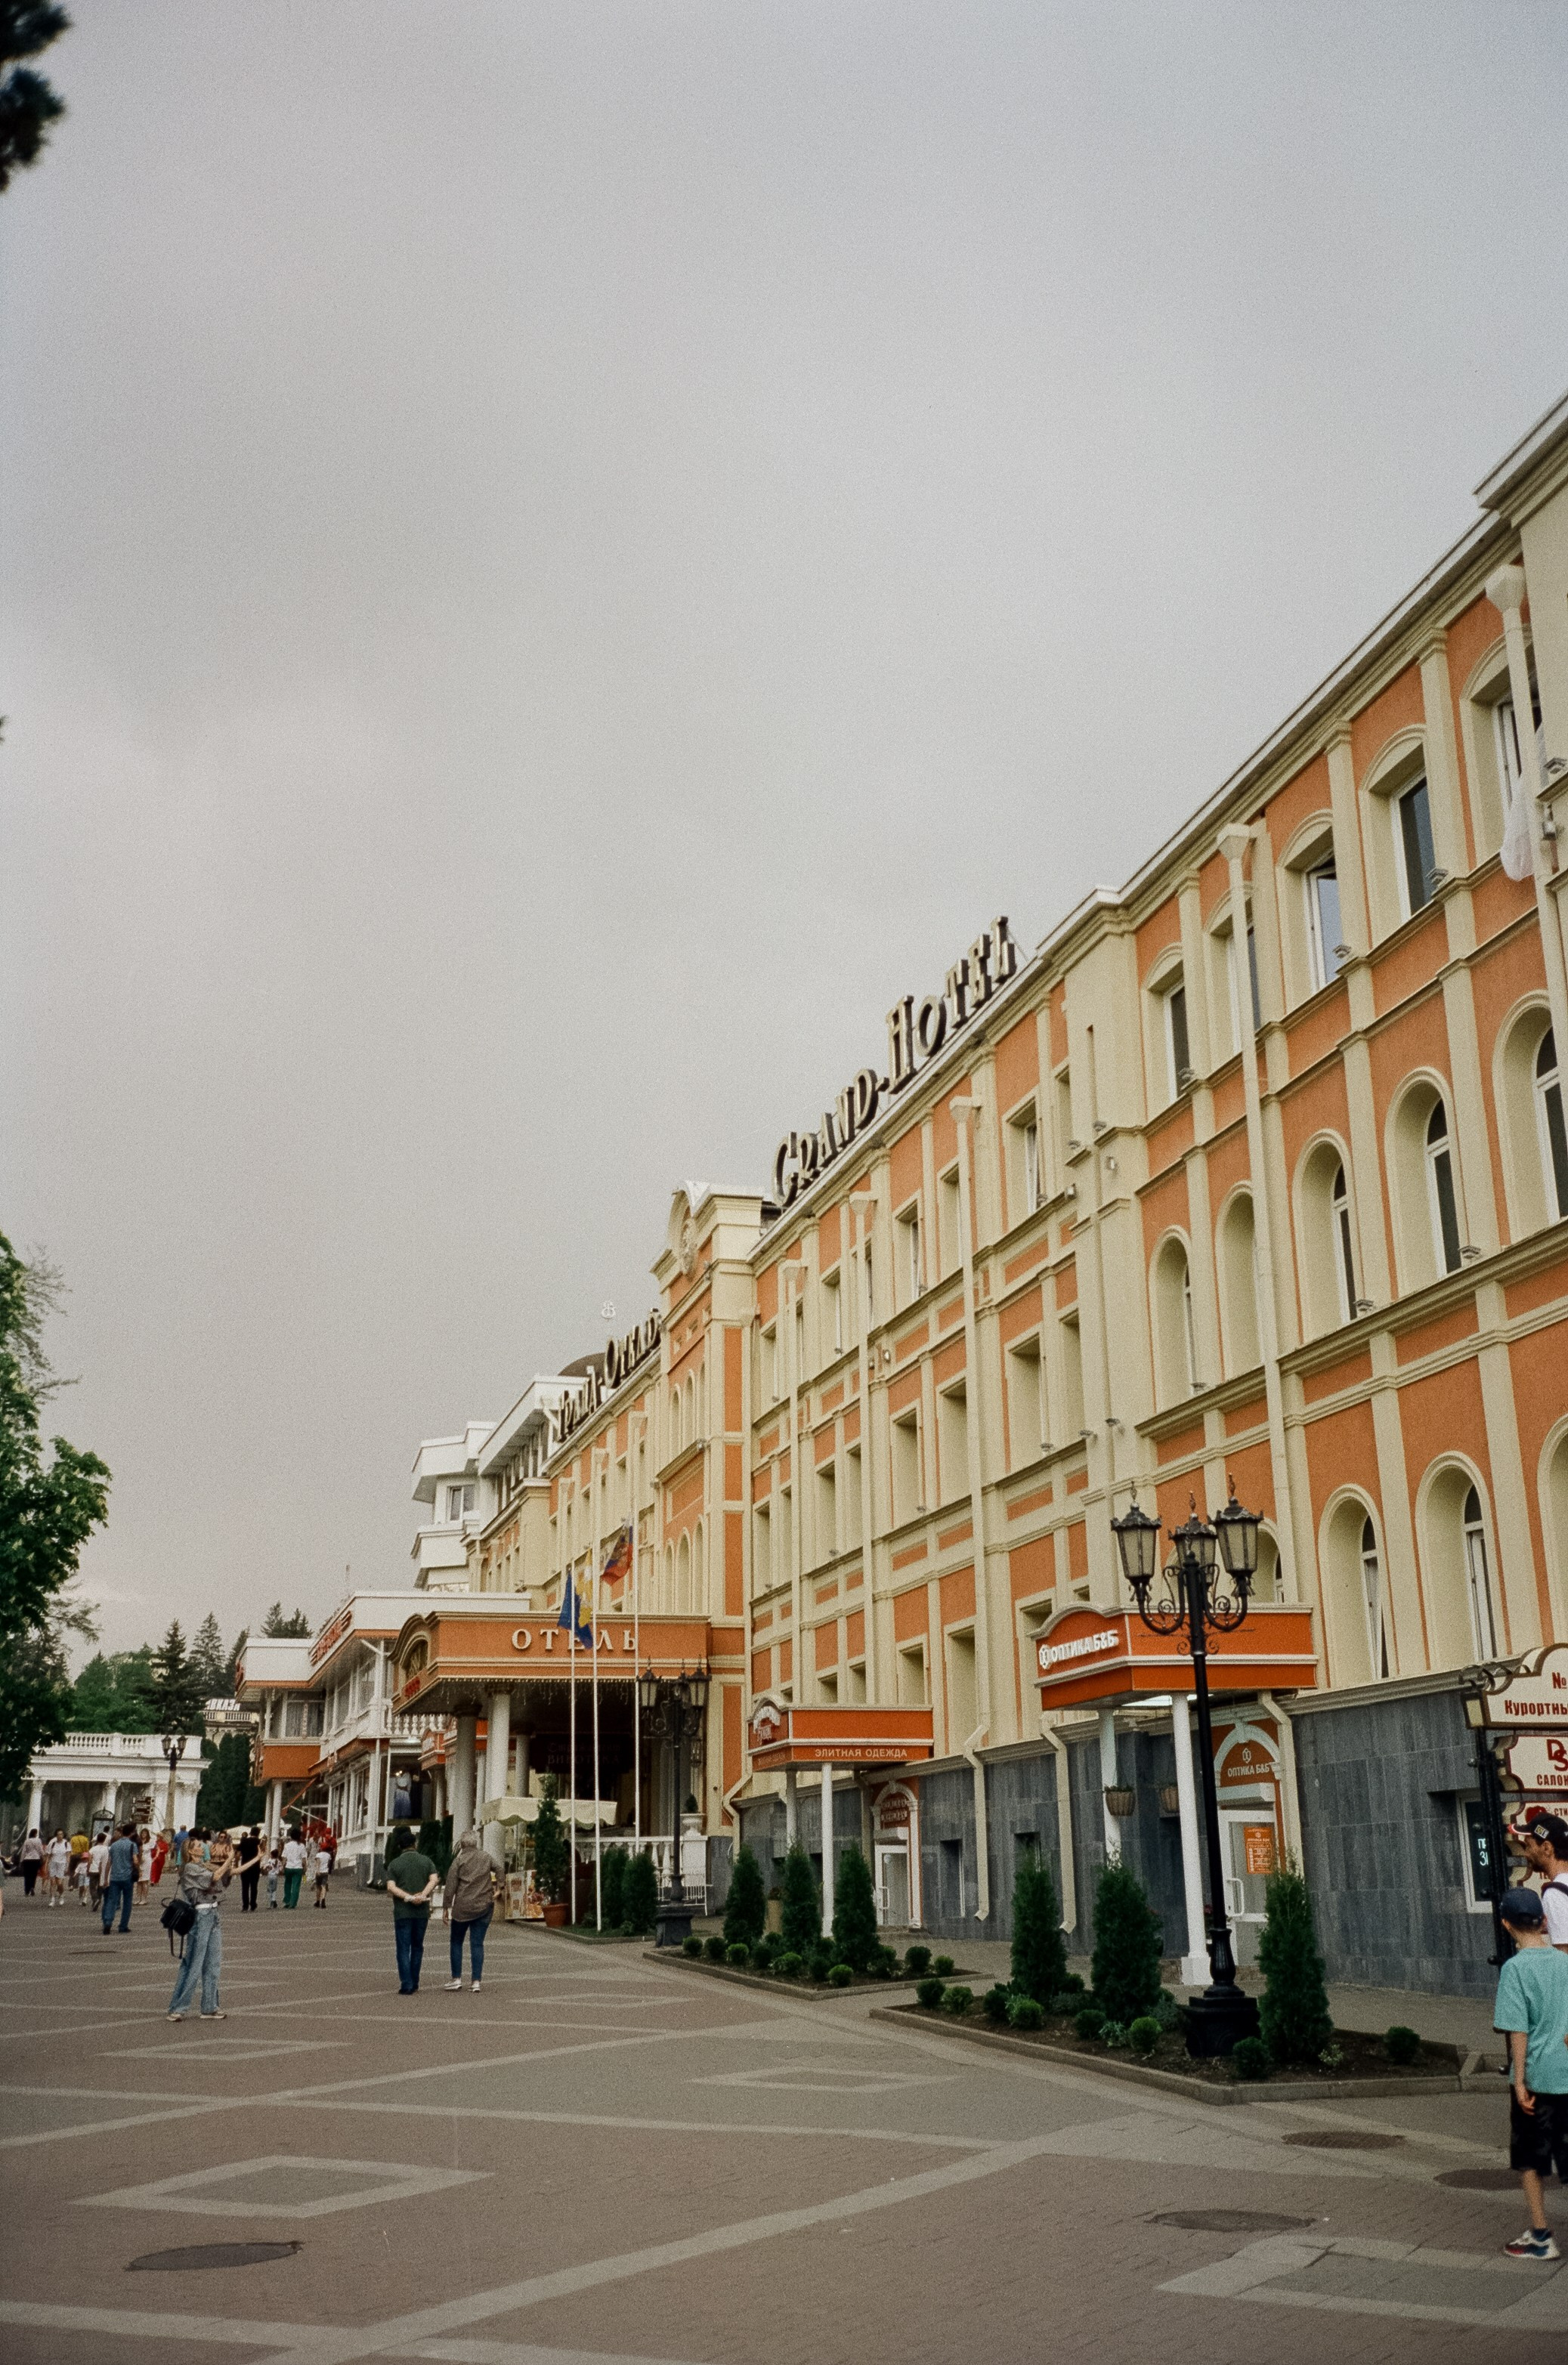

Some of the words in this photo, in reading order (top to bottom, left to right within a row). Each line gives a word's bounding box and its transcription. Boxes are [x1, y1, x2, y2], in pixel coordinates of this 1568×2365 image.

[512, 1628, 637, 1650] ОТЕЛЬ
[1051, 1636, 1094, 1663] ОПТИКА
[815, 1748, 861, 1758] ЭЛИТНАЯ
[865, 1748, 908, 1758] ОДЕЖДА
[1227, 1764, 1255, 1777] ОПТИКА
